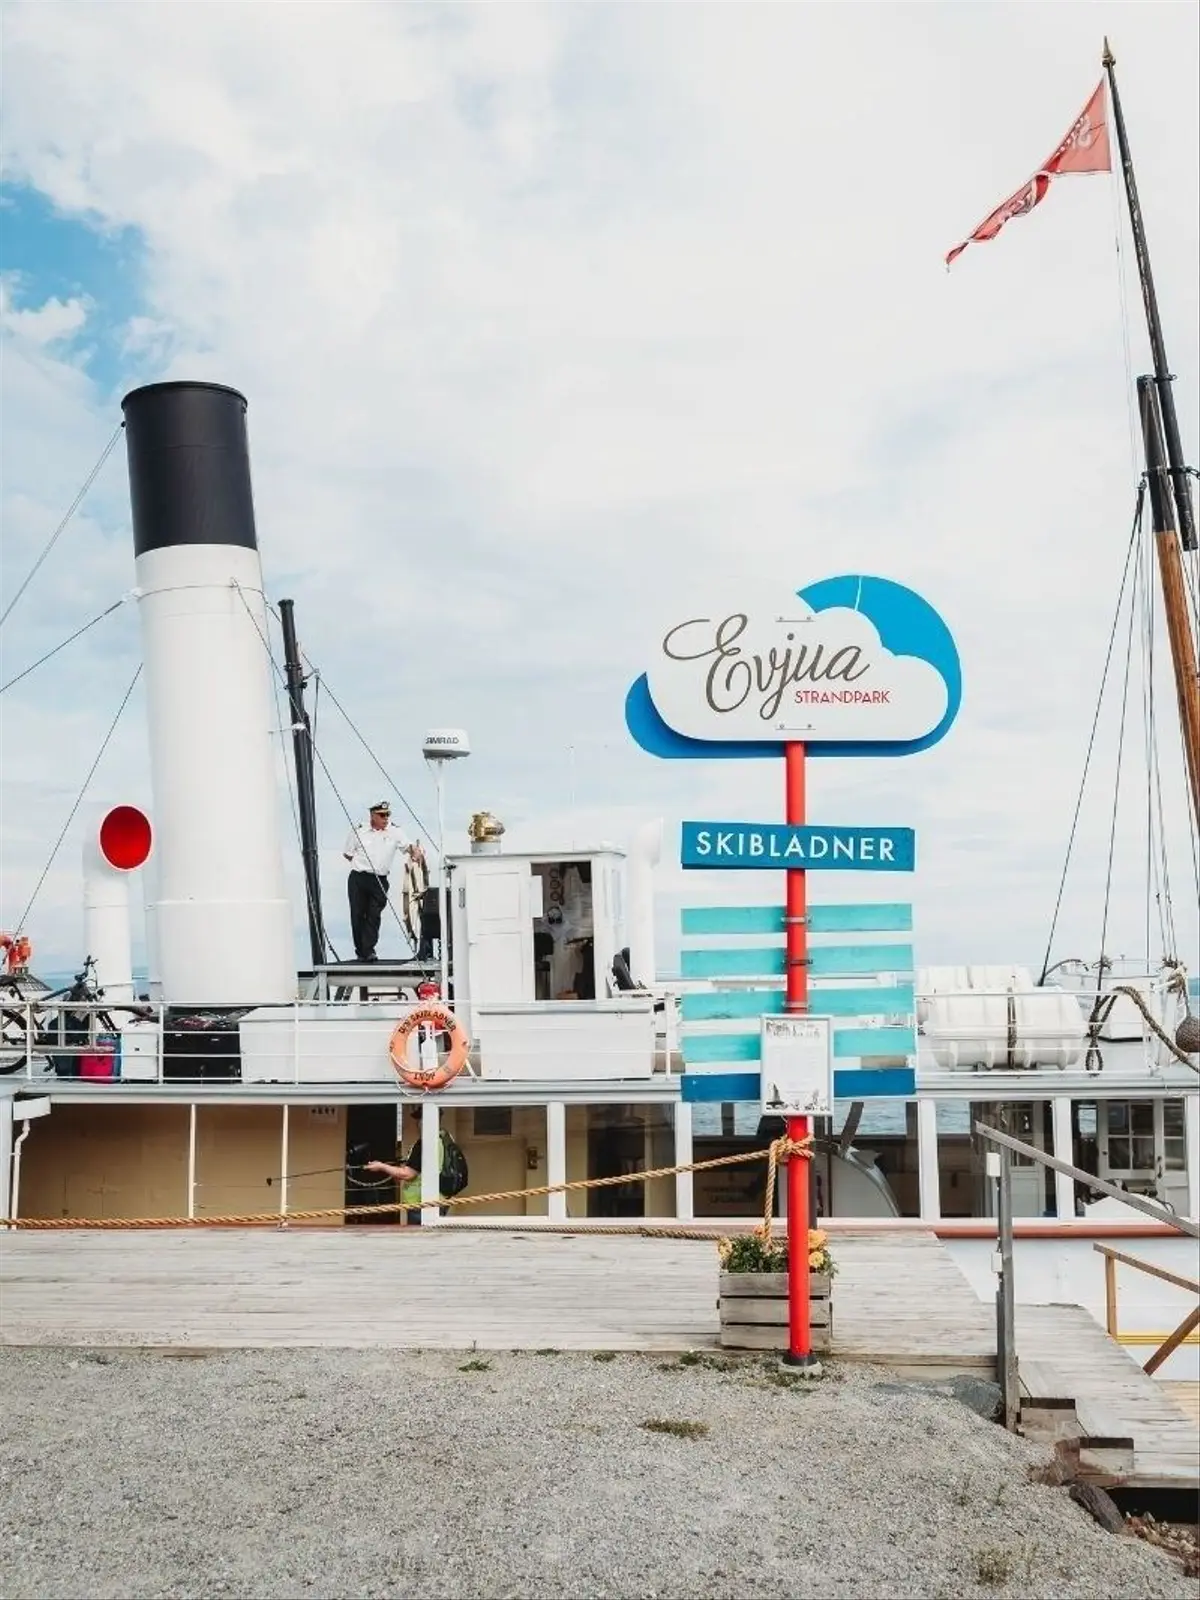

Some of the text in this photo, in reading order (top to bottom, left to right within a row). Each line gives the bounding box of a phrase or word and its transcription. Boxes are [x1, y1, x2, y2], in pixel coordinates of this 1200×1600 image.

[662, 613, 870, 721] Evjua
[794, 690, 891, 704] STRANDPARK
[696, 831, 895, 862] SKIBLADNER
